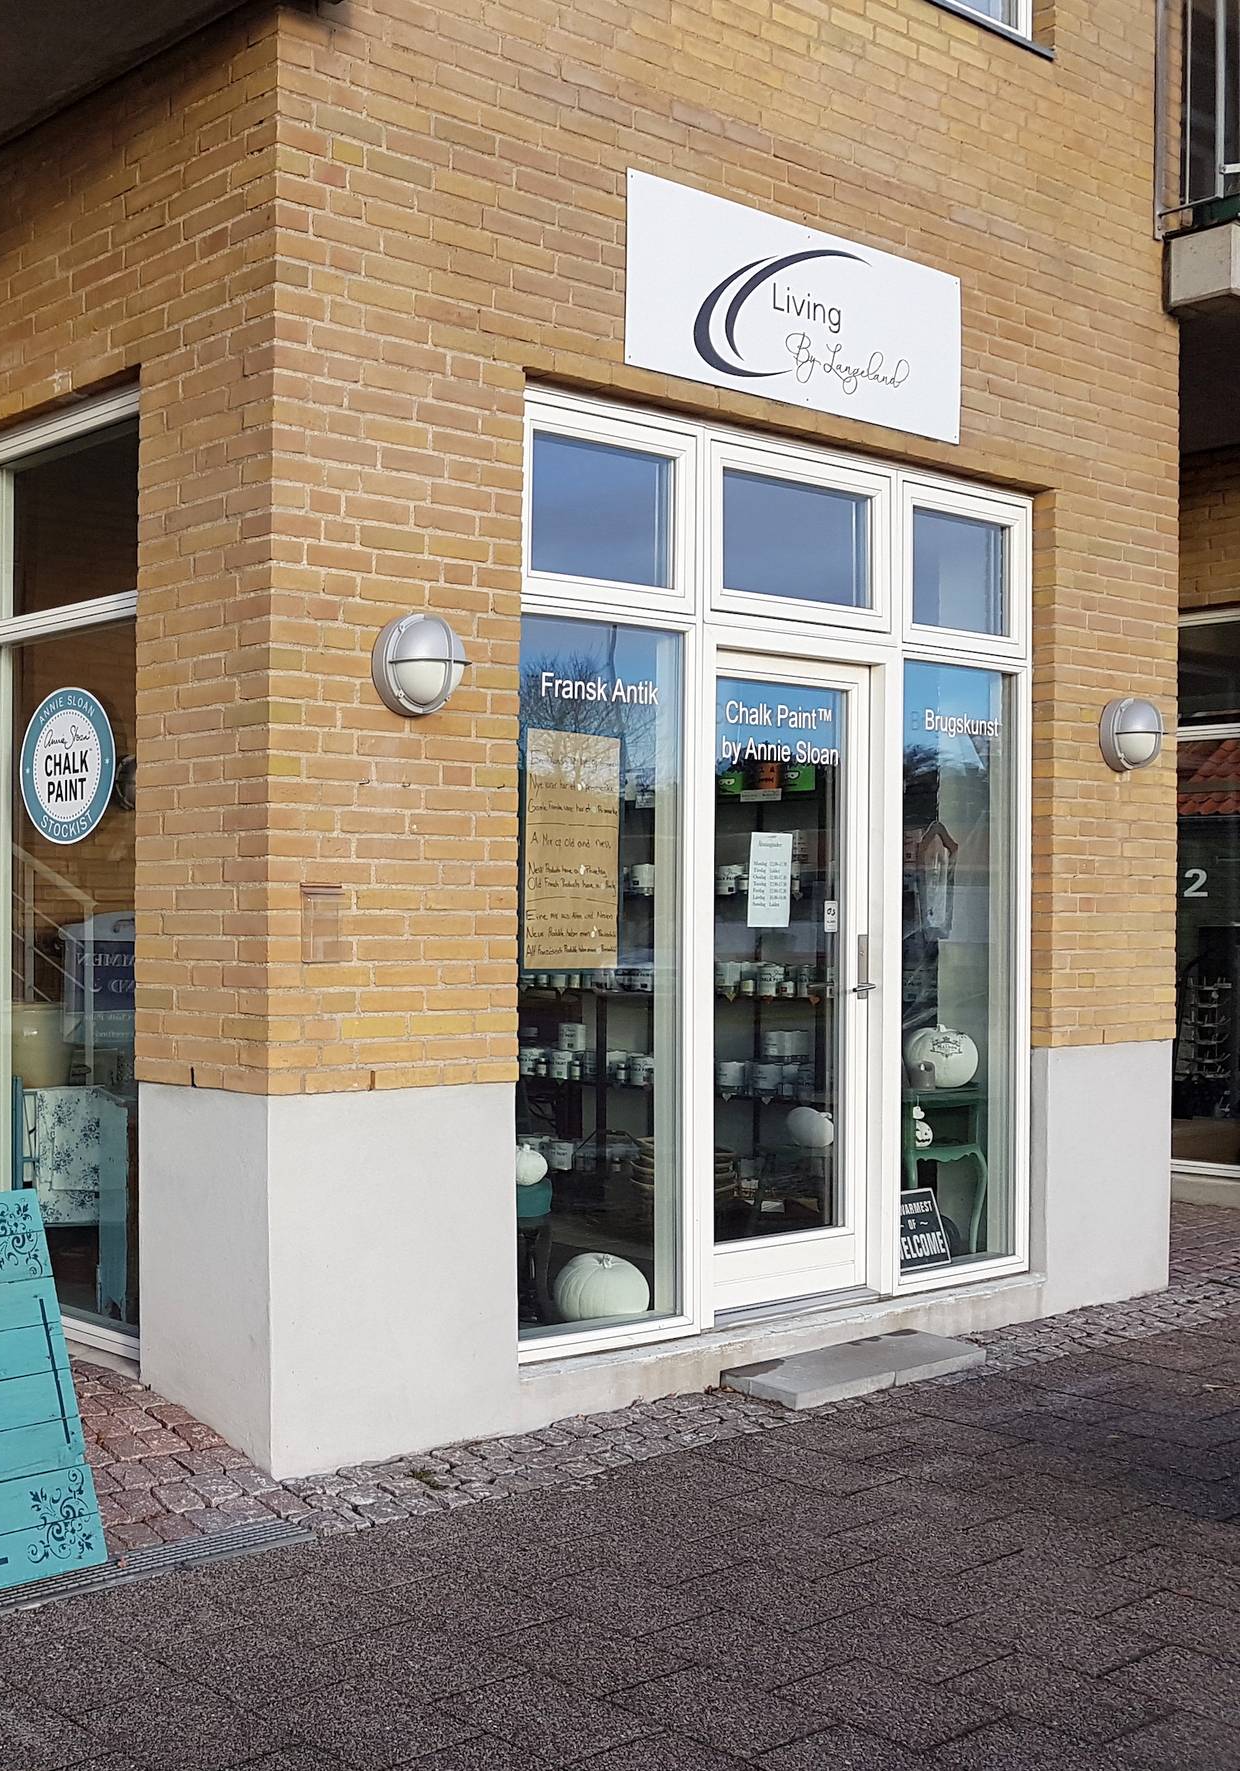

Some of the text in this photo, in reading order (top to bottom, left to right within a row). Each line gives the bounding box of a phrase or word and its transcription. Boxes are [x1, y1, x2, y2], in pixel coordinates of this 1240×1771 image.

[773, 282, 841, 333] Living
[785, 332, 910, 395] By Langeland
[541, 672, 659, 705] Fransk Antik
[39, 695, 95, 725] ANNIE SLOAN
[726, 700, 772, 726] Chalk
[925, 708, 999, 738] Brugskunst
[44, 729, 68, 750] Annie
[722, 735, 839, 766] by Annie Sloan
[45, 750, 89, 777] CHALK
[48, 778, 86, 803] PAINT
[40, 810, 93, 838] STOCKIST
[1183, 868, 1208, 897] 2
[908, 1219, 917, 1230] OF
[900, 1231, 946, 1260] ELCOME
